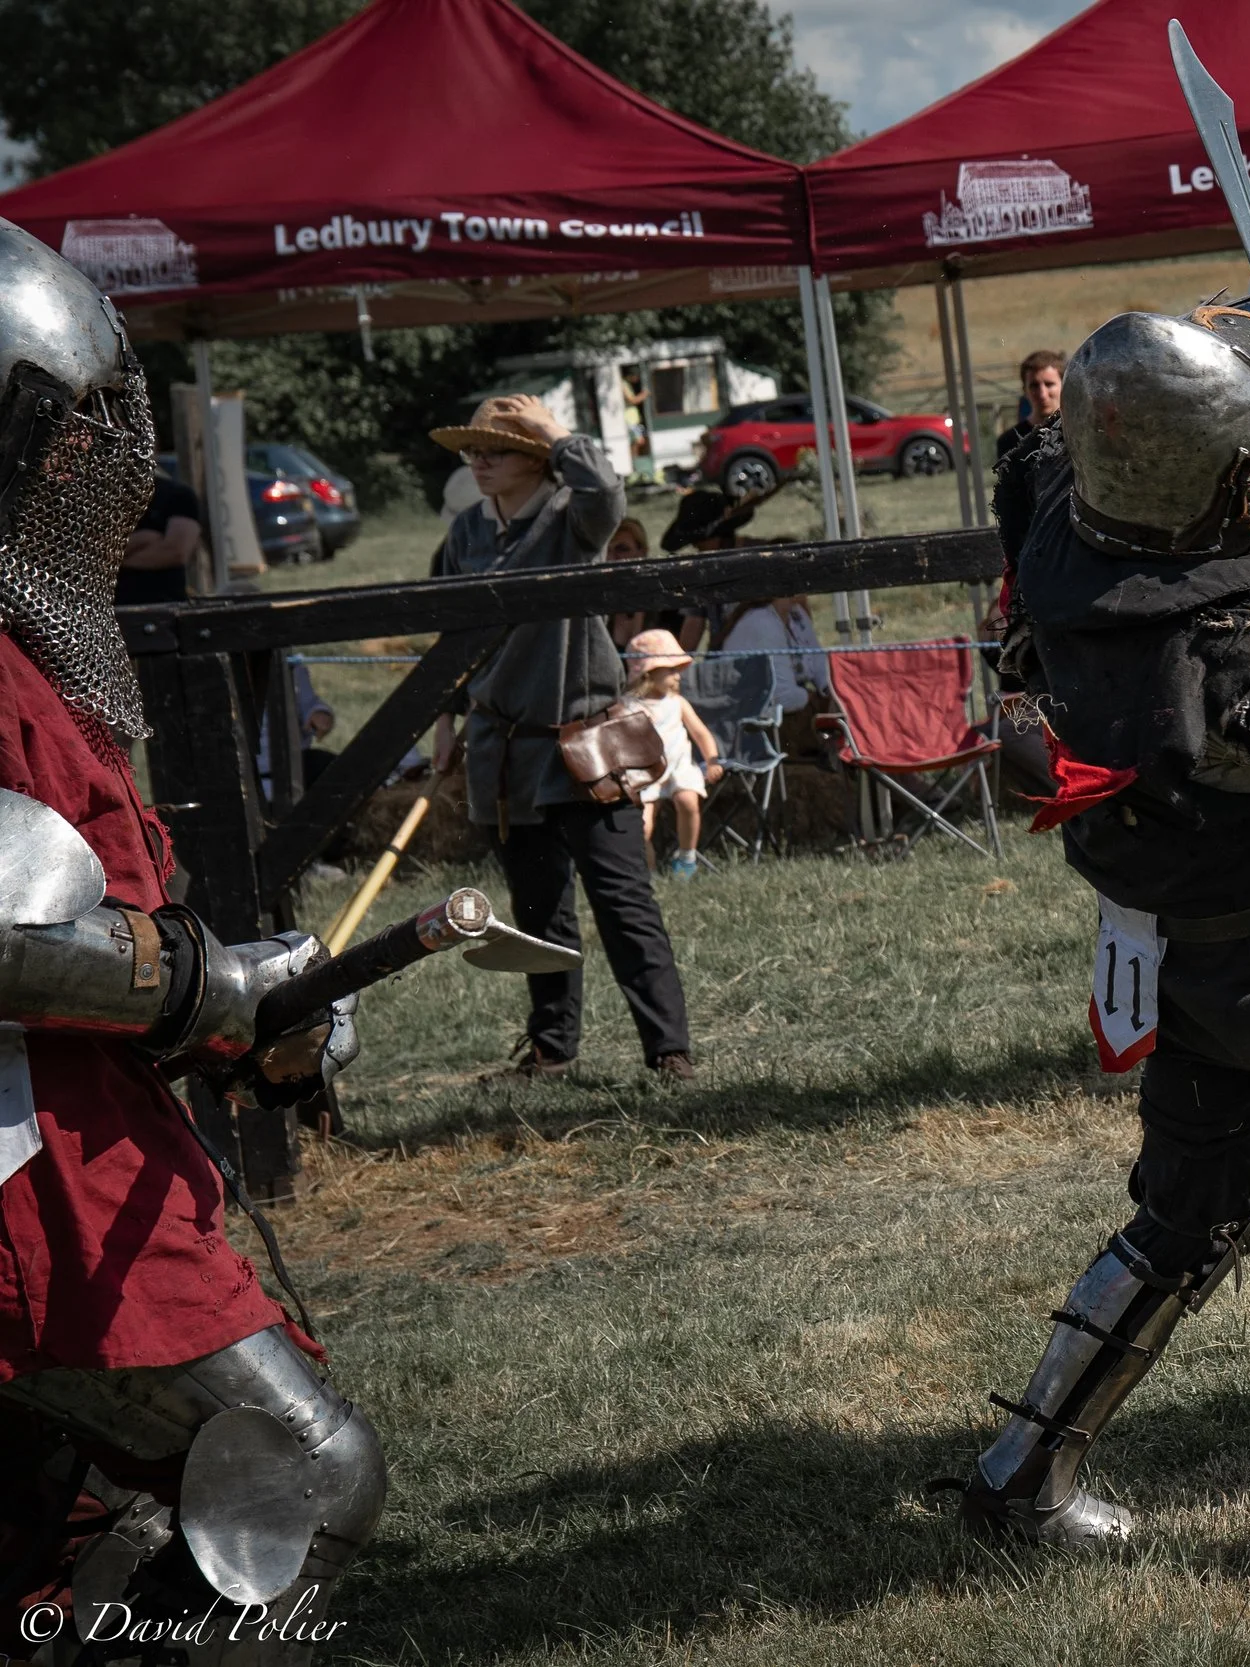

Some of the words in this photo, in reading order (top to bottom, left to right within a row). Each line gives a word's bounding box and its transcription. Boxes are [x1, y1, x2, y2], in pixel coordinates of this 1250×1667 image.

[273, 214, 433, 255] Ledbury
[440, 211, 549, 242] Town
[559, 210, 704, 238] Council
[1103, 941, 1145, 1032] 11
